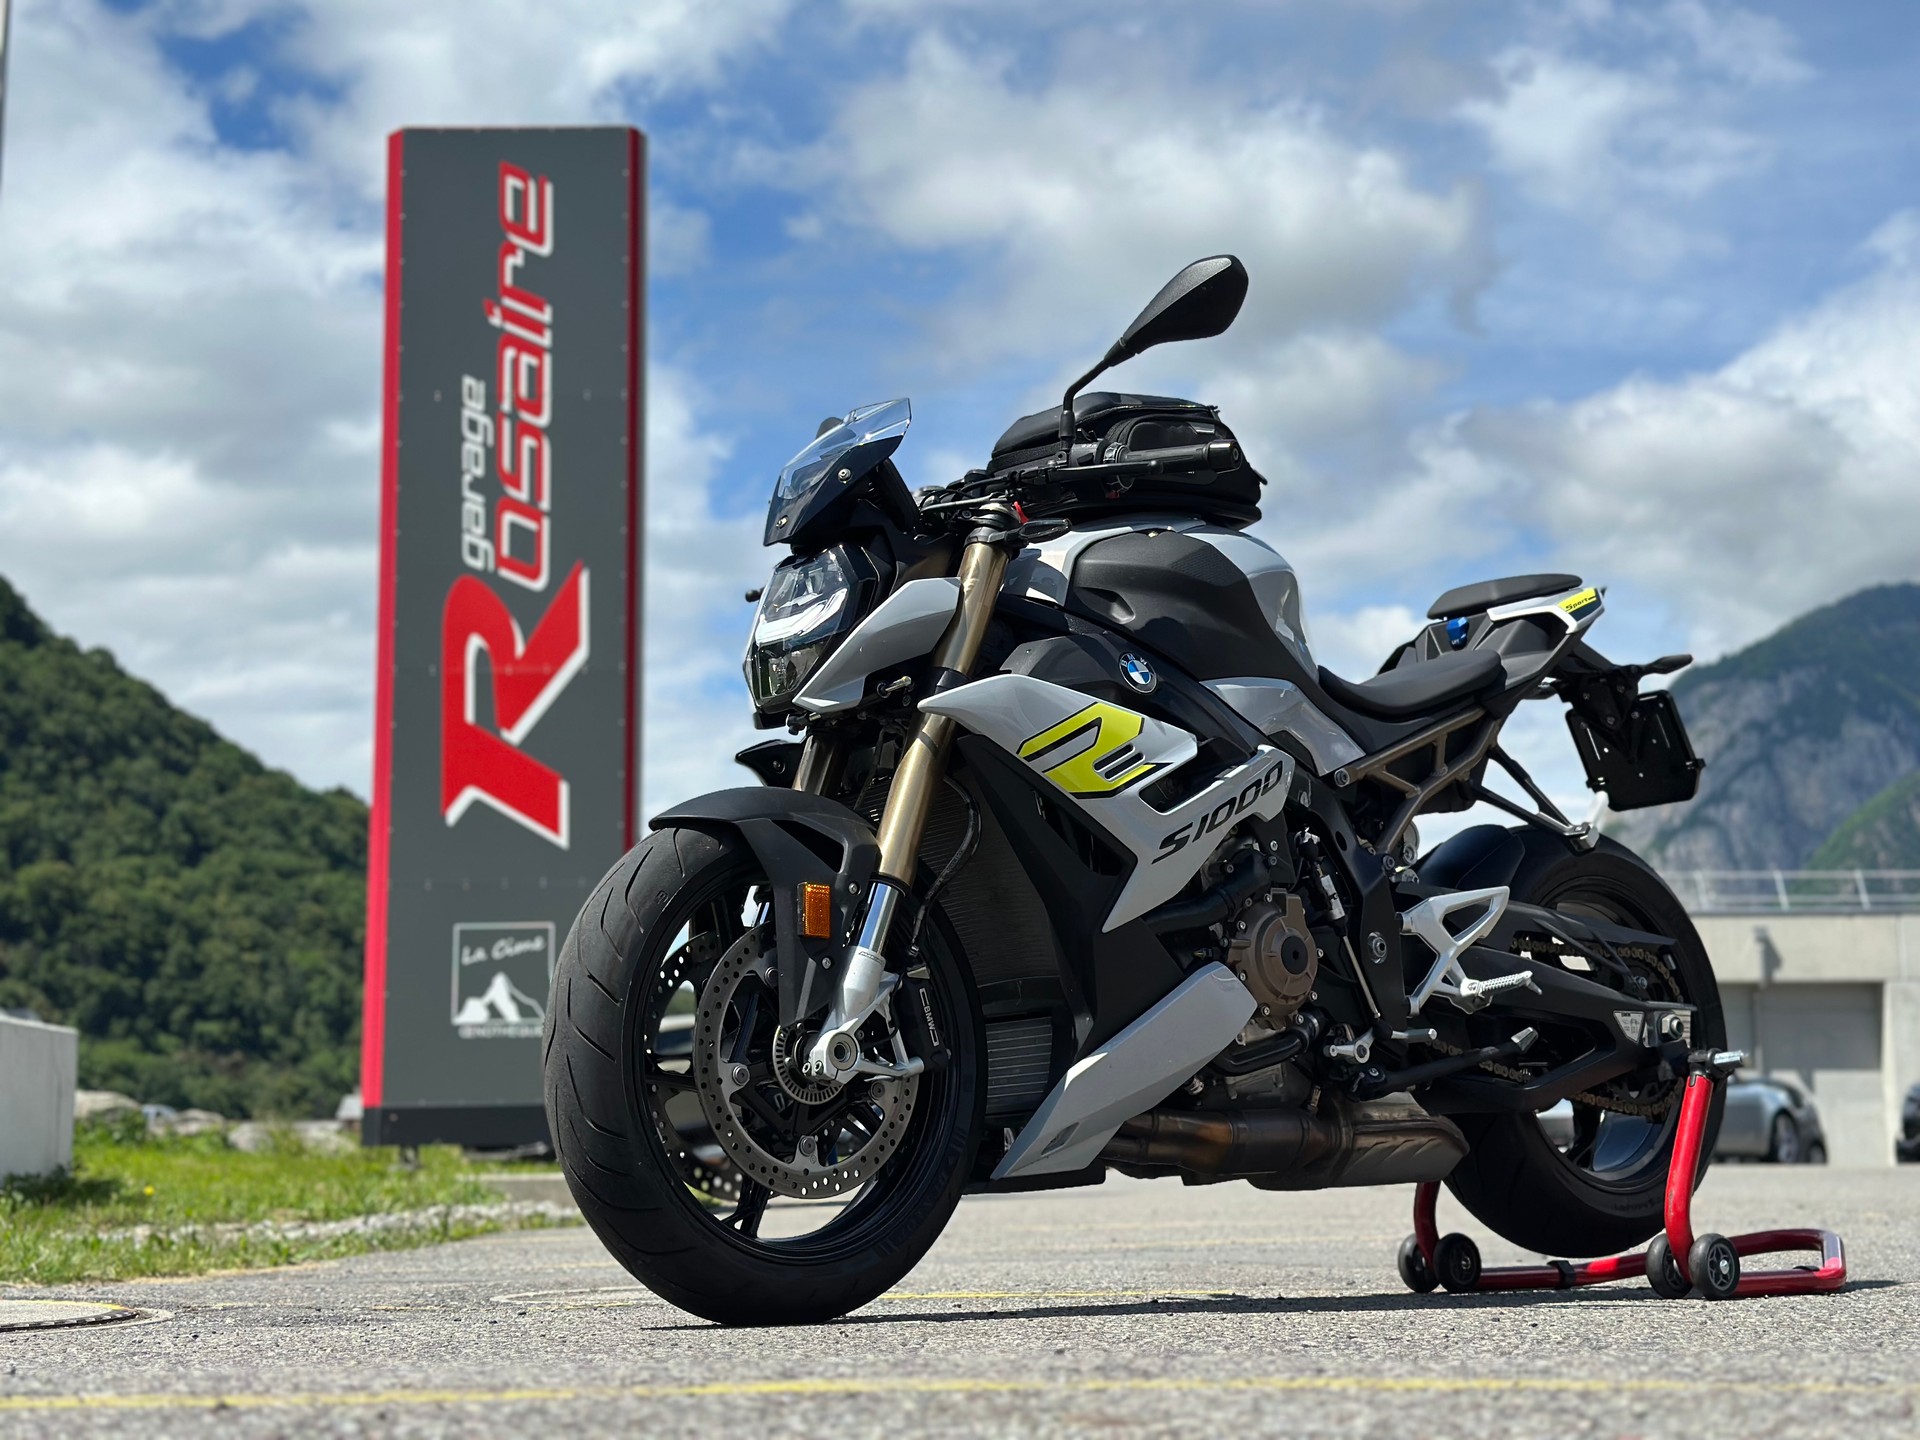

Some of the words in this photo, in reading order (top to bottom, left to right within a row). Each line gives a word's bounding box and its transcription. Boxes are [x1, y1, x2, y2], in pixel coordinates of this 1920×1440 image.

[441, 160, 590, 850] Rosaire
[461, 375, 495, 572] garage
[1565, 597, 1589, 611] Sport
[1151, 760, 1283, 865] S1000
[923, 1005, 936, 1030] BMW
